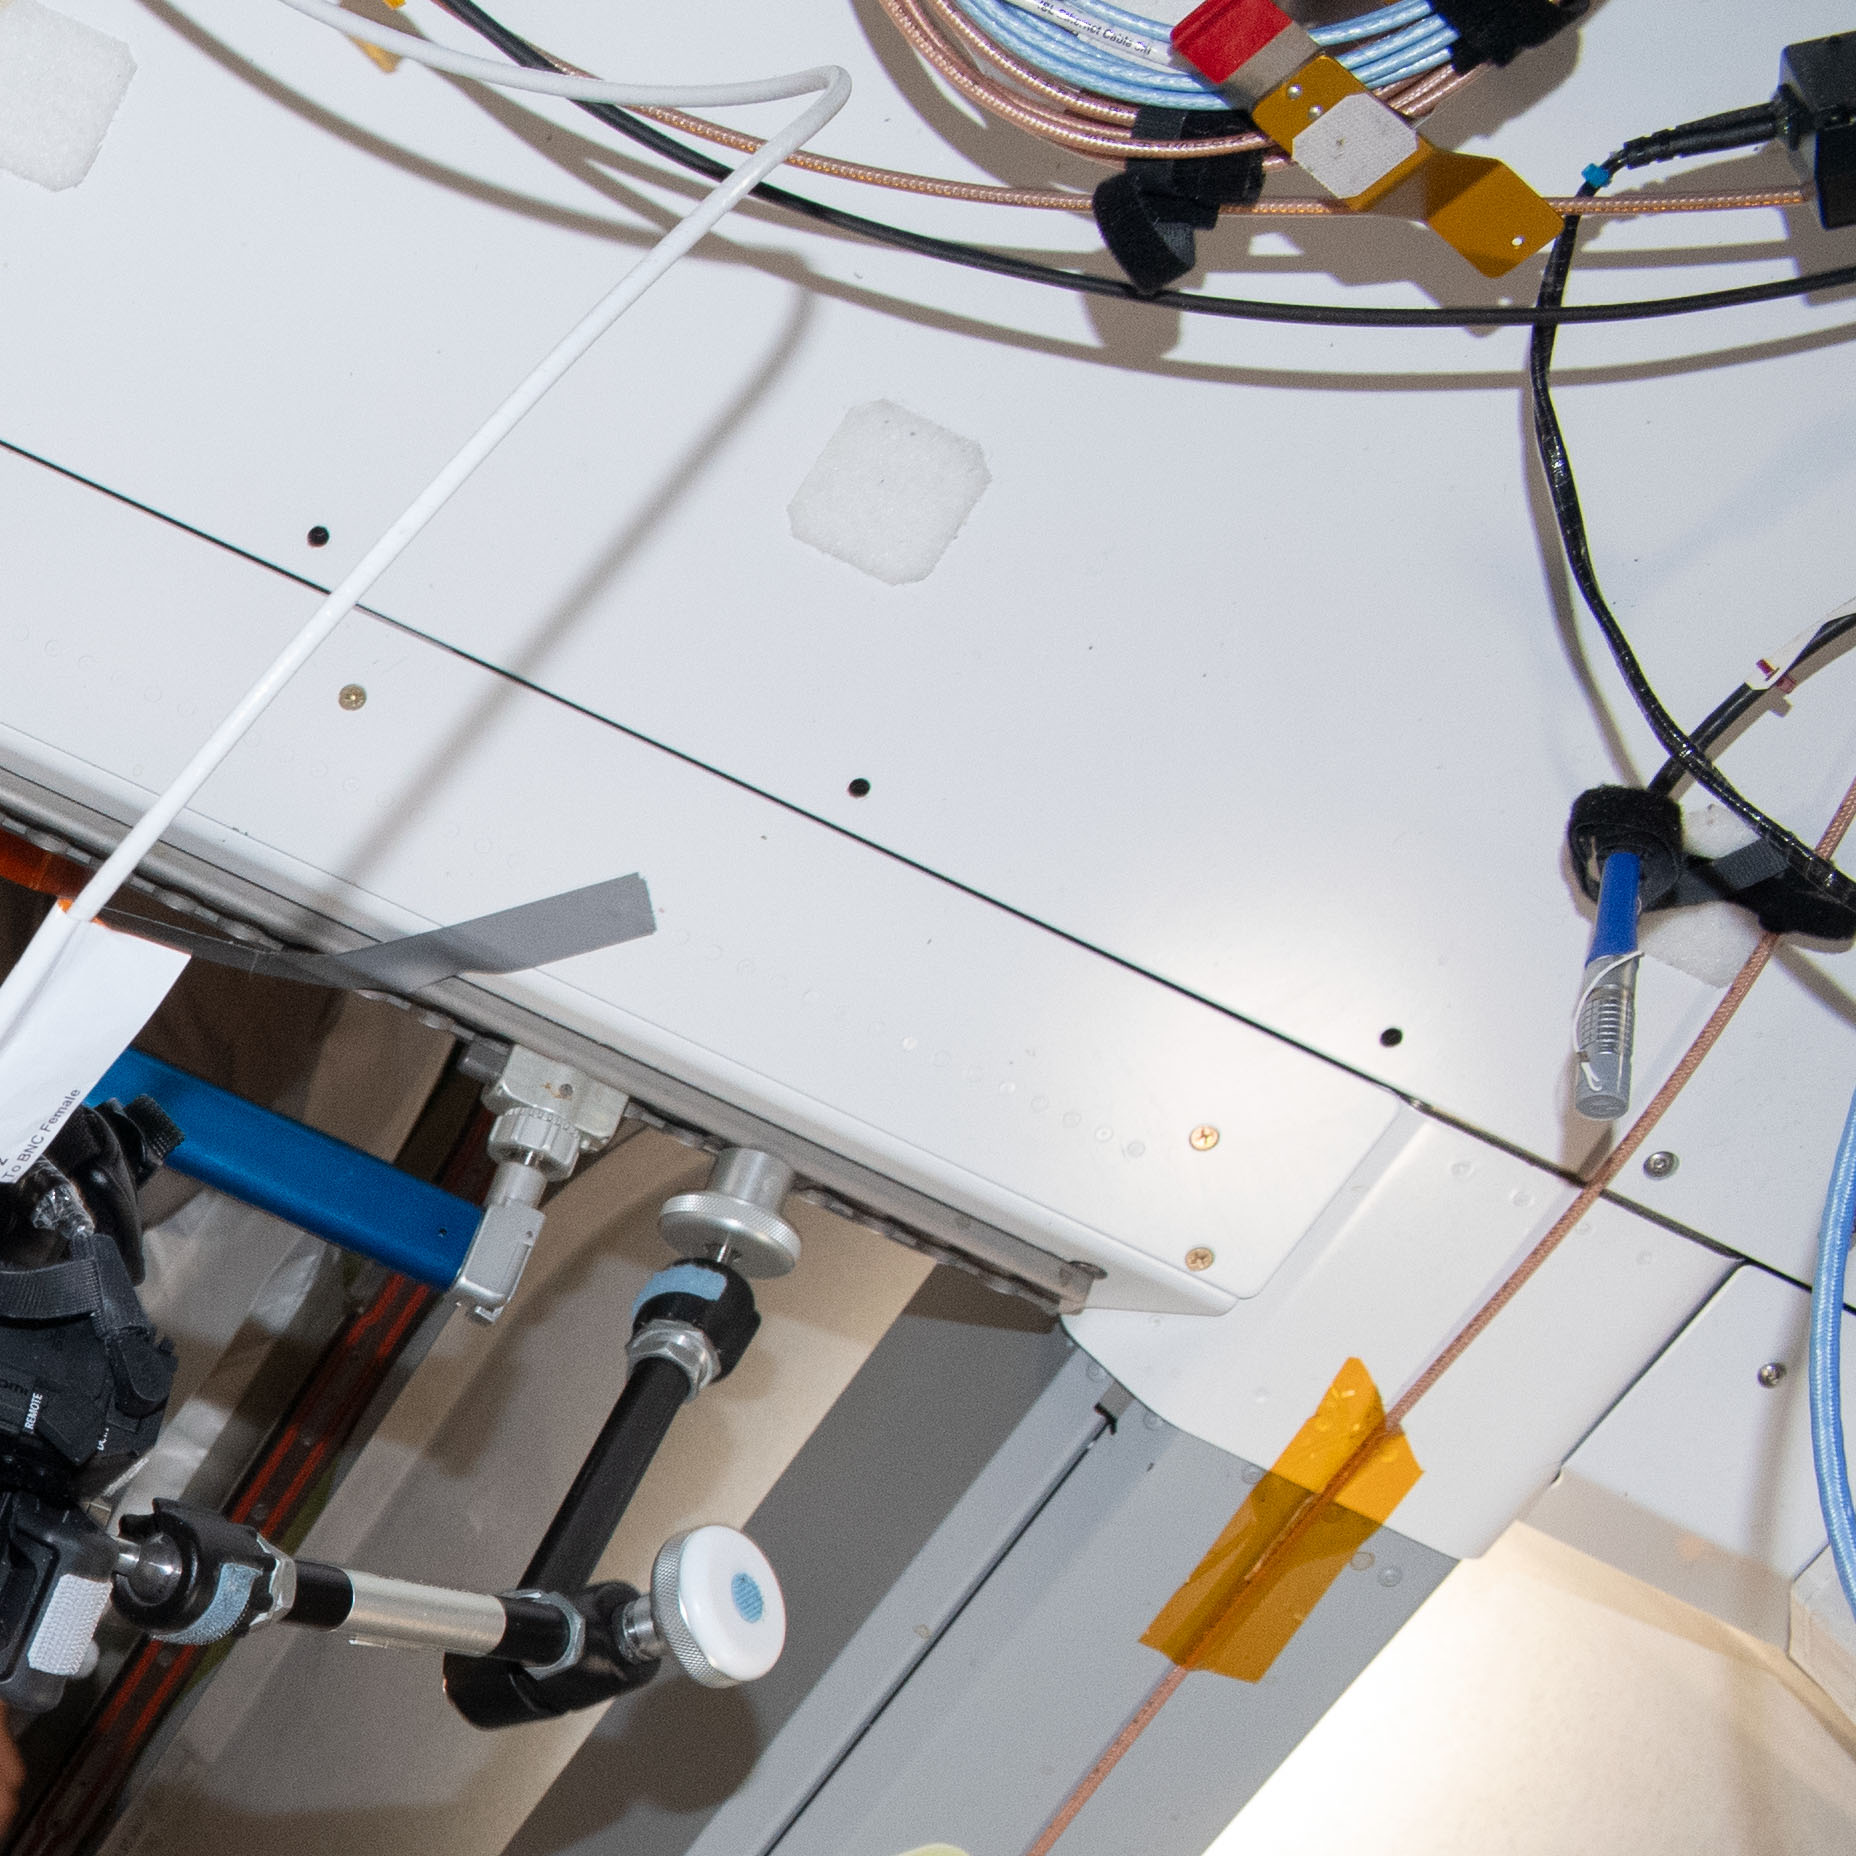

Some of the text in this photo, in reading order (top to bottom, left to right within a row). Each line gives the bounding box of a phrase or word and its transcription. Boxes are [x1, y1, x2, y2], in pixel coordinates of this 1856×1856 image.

[1, 1087, 81, 1177] To BNC Female
[24, 1392, 42, 1429] REMOTE
